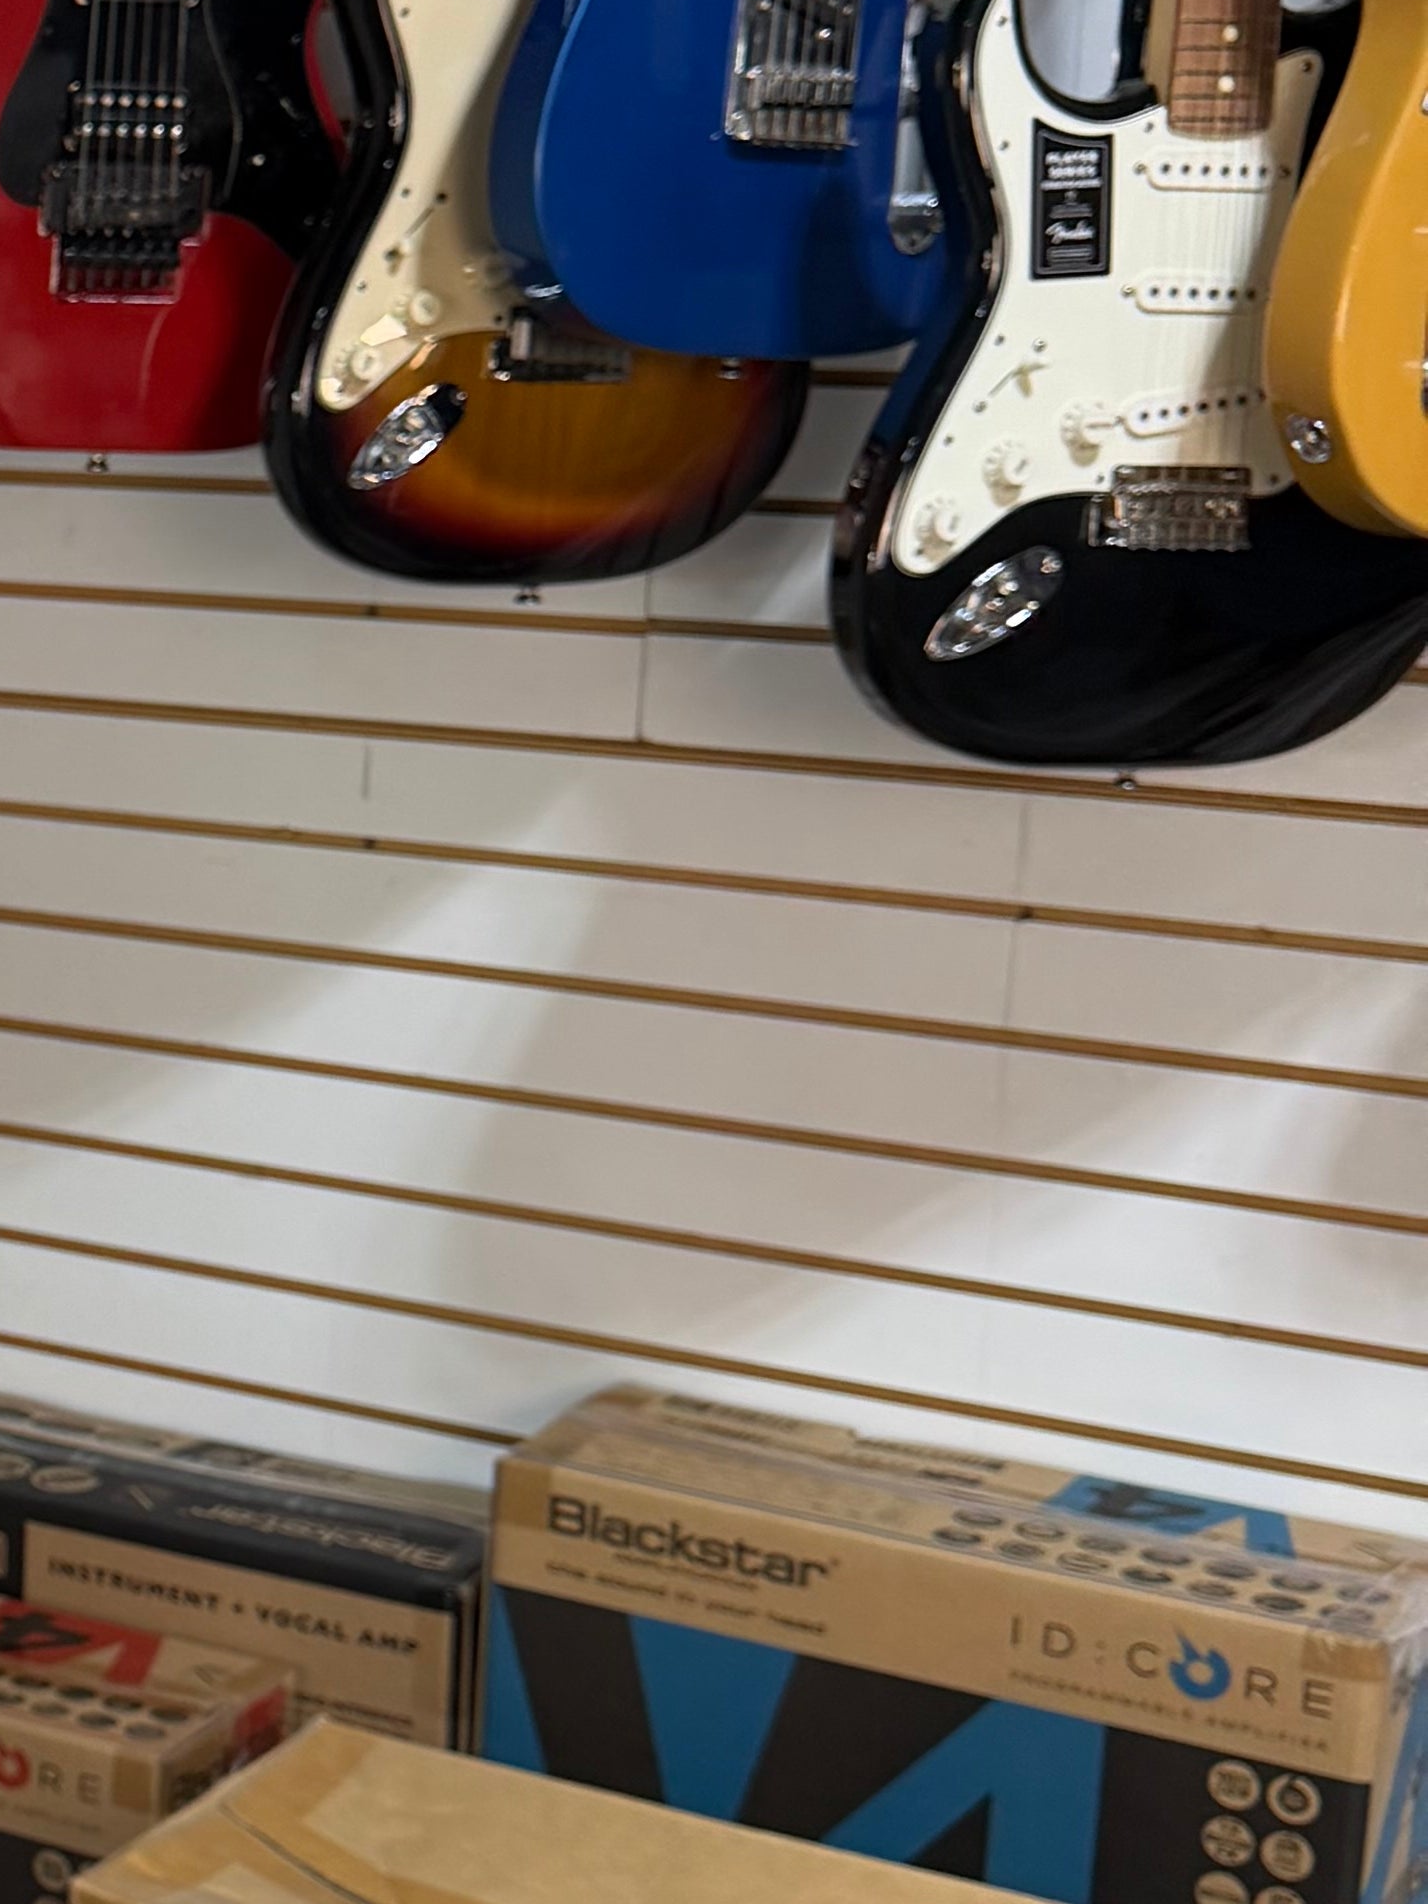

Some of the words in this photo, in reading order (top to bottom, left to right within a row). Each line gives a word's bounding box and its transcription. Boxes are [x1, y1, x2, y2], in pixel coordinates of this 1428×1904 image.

[547, 1493, 829, 1587] Blackstar
[47, 1557, 219, 1613] INSTRUMENT
[253, 1601, 347, 1643] VOCAL
[356, 1626, 422, 1657] AMP
